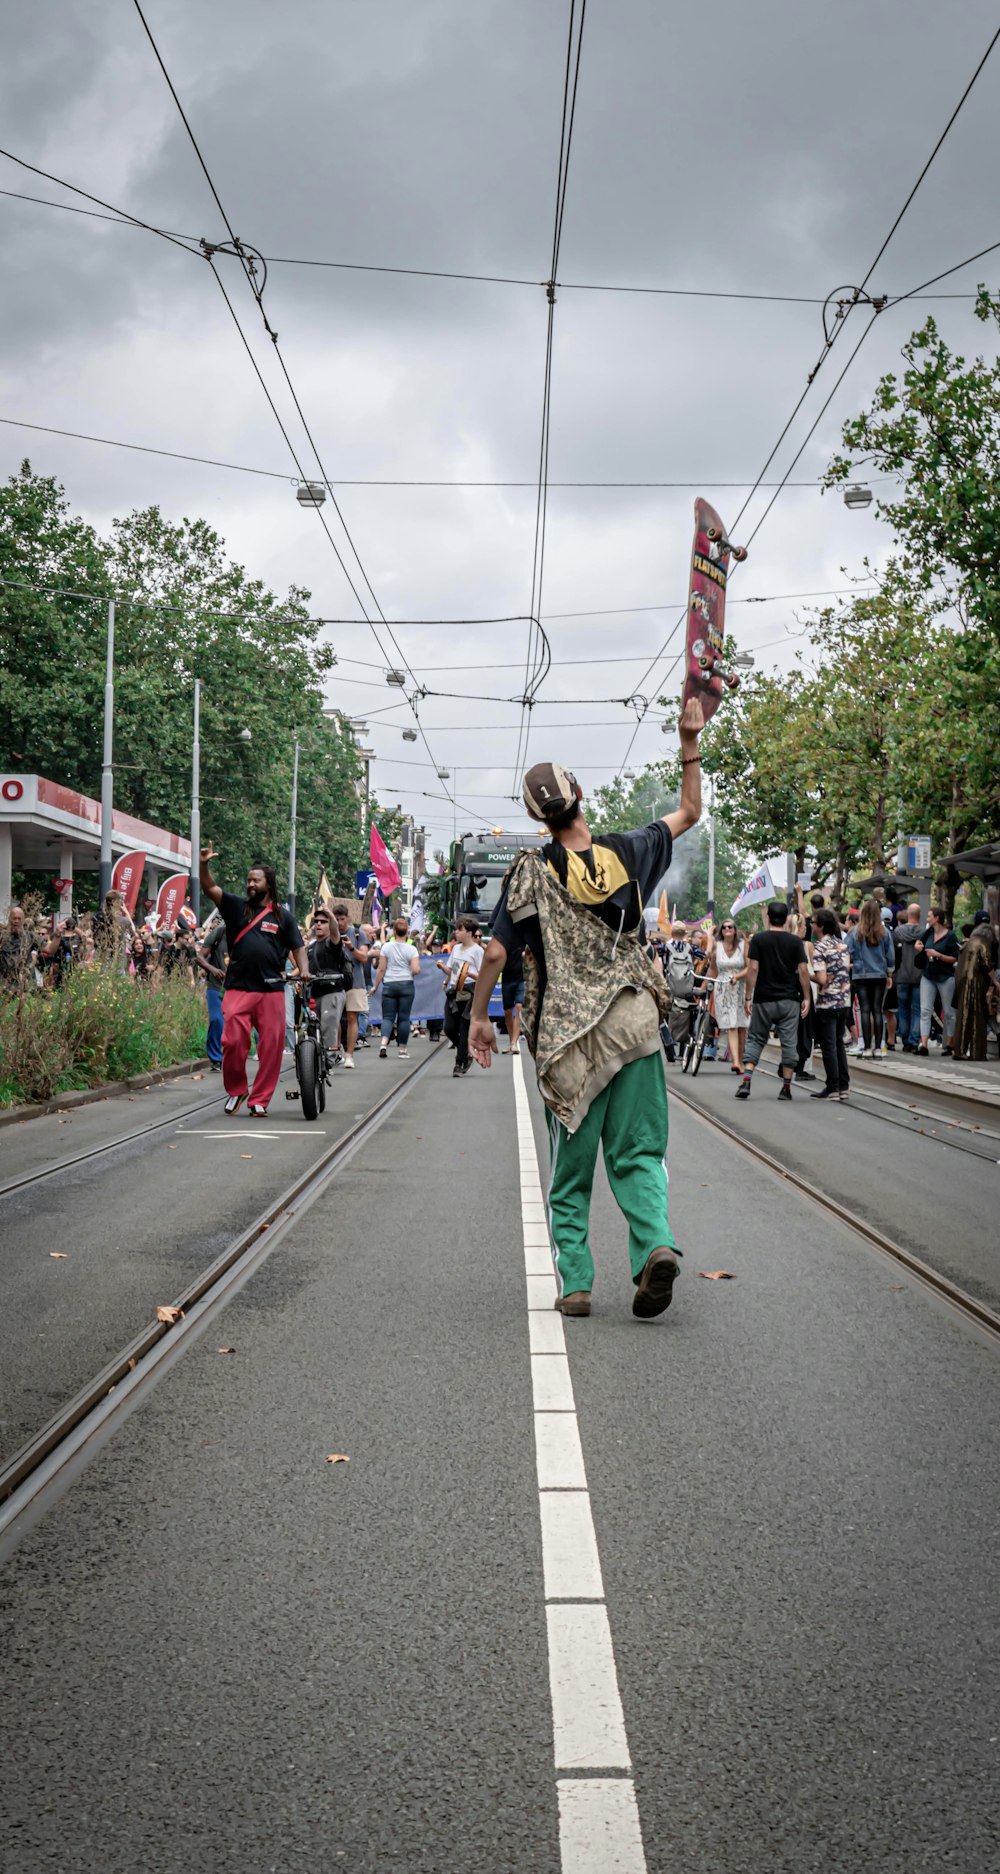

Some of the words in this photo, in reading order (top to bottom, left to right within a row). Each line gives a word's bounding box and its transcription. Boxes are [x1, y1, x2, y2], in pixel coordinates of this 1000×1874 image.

[540, 786, 551, 799] 1
[121, 867, 132, 881] Blij
[120, 880, 130, 890] je
[166, 889, 176, 901] Blij
[166, 901, 174, 909] je
